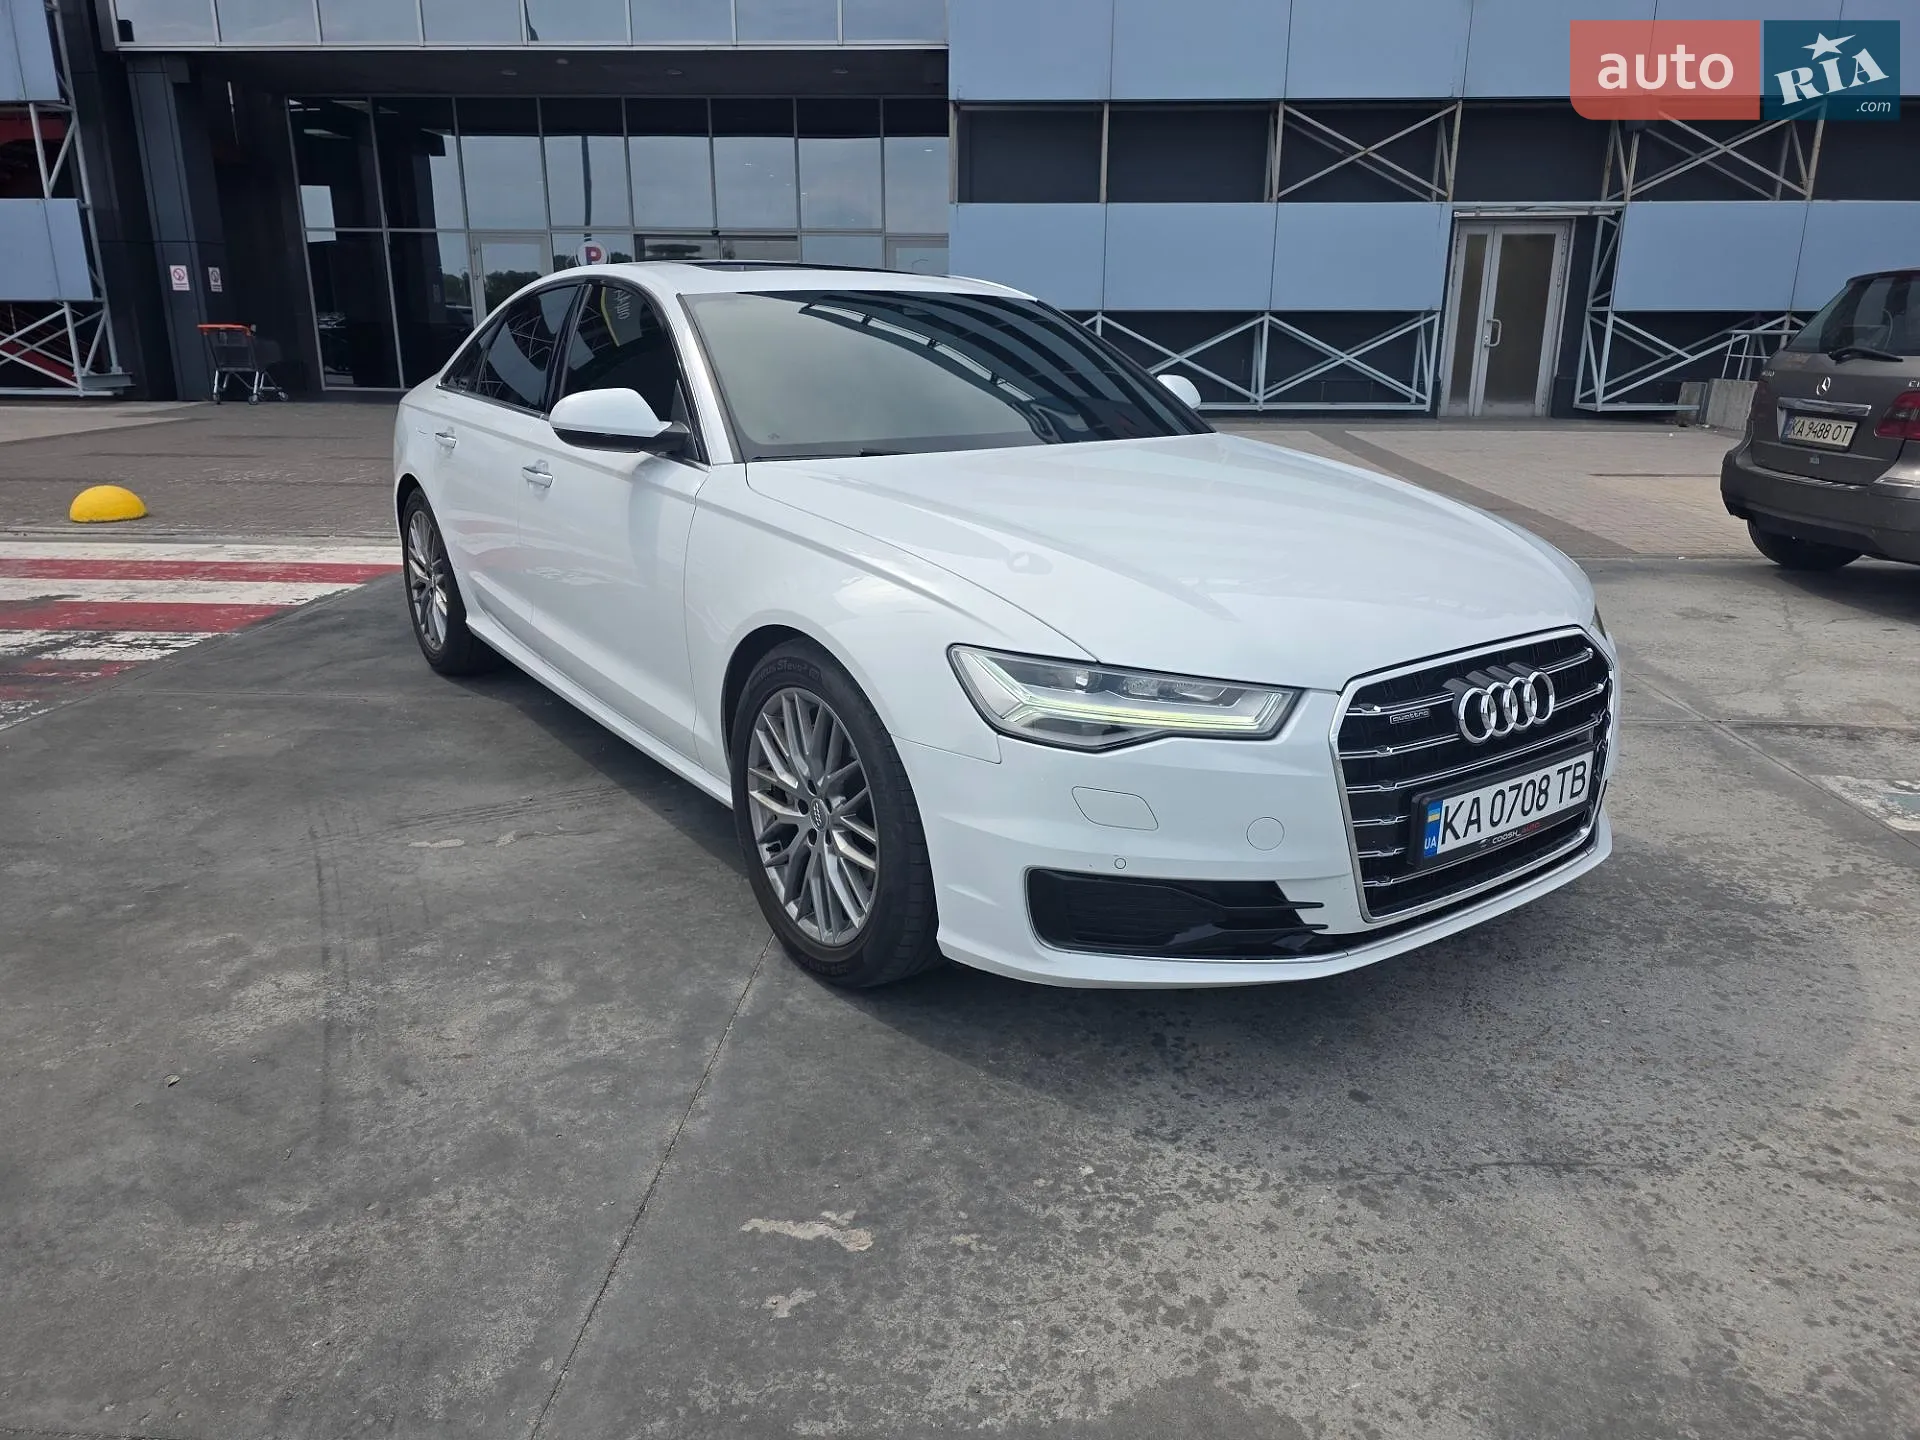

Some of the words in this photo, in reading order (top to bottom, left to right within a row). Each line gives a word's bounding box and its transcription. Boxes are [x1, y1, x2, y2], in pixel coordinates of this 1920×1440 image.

[1791, 419, 1806, 437] KA
[1806, 421, 1832, 439] 9488
[1832, 425, 1853, 442] OT
[1440, 796, 1482, 845] KA
[1489, 774, 1550, 828] 0708
[1556, 760, 1587, 804] TB
[1424, 835, 1437, 850] UA
